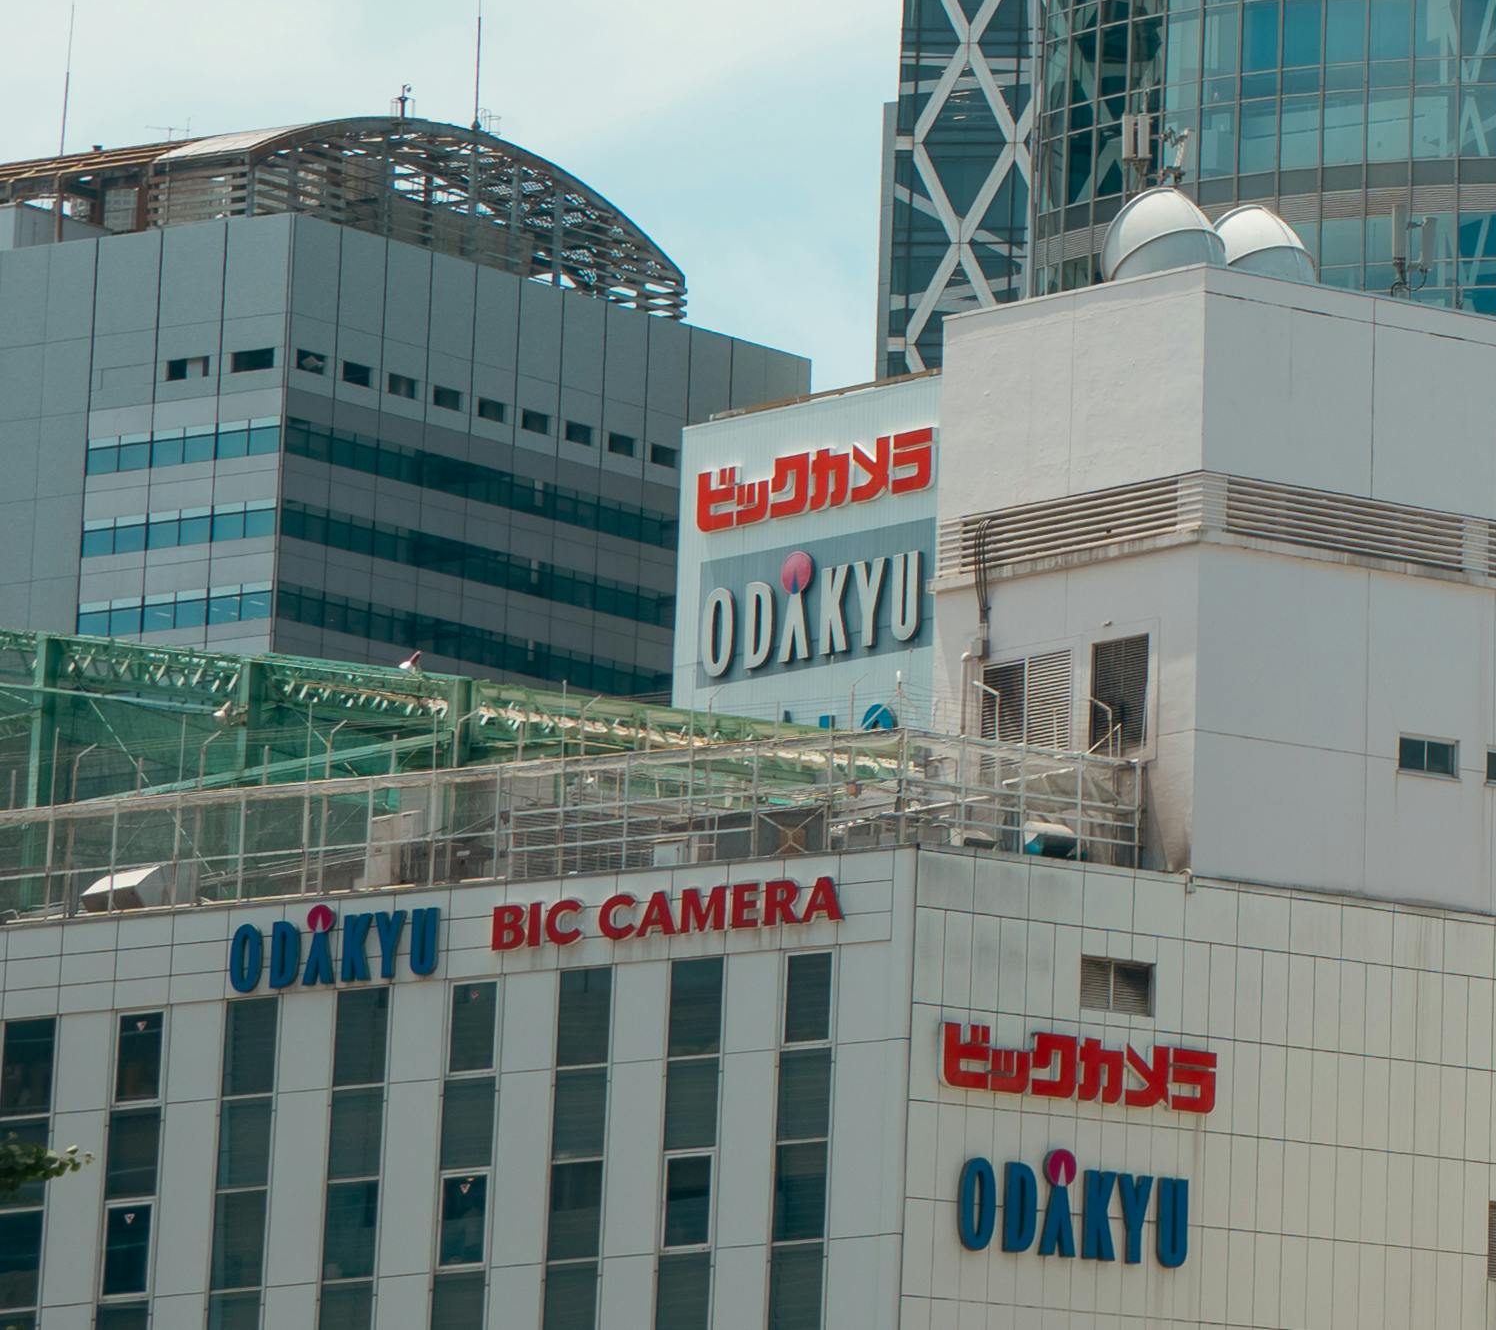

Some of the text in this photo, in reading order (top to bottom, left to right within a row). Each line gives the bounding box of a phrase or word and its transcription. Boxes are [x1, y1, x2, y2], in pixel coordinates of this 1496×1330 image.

[696, 427, 935, 533] ビックカメラ
[701, 549, 923, 679] ODAKYU
[229, 904, 441, 994] ODAKYU
[490, 876, 845, 953] BIC CAMERA
[940, 1021, 1219, 1115] ビックカメラ
[957, 1148, 1190, 1269] ODAKYU
